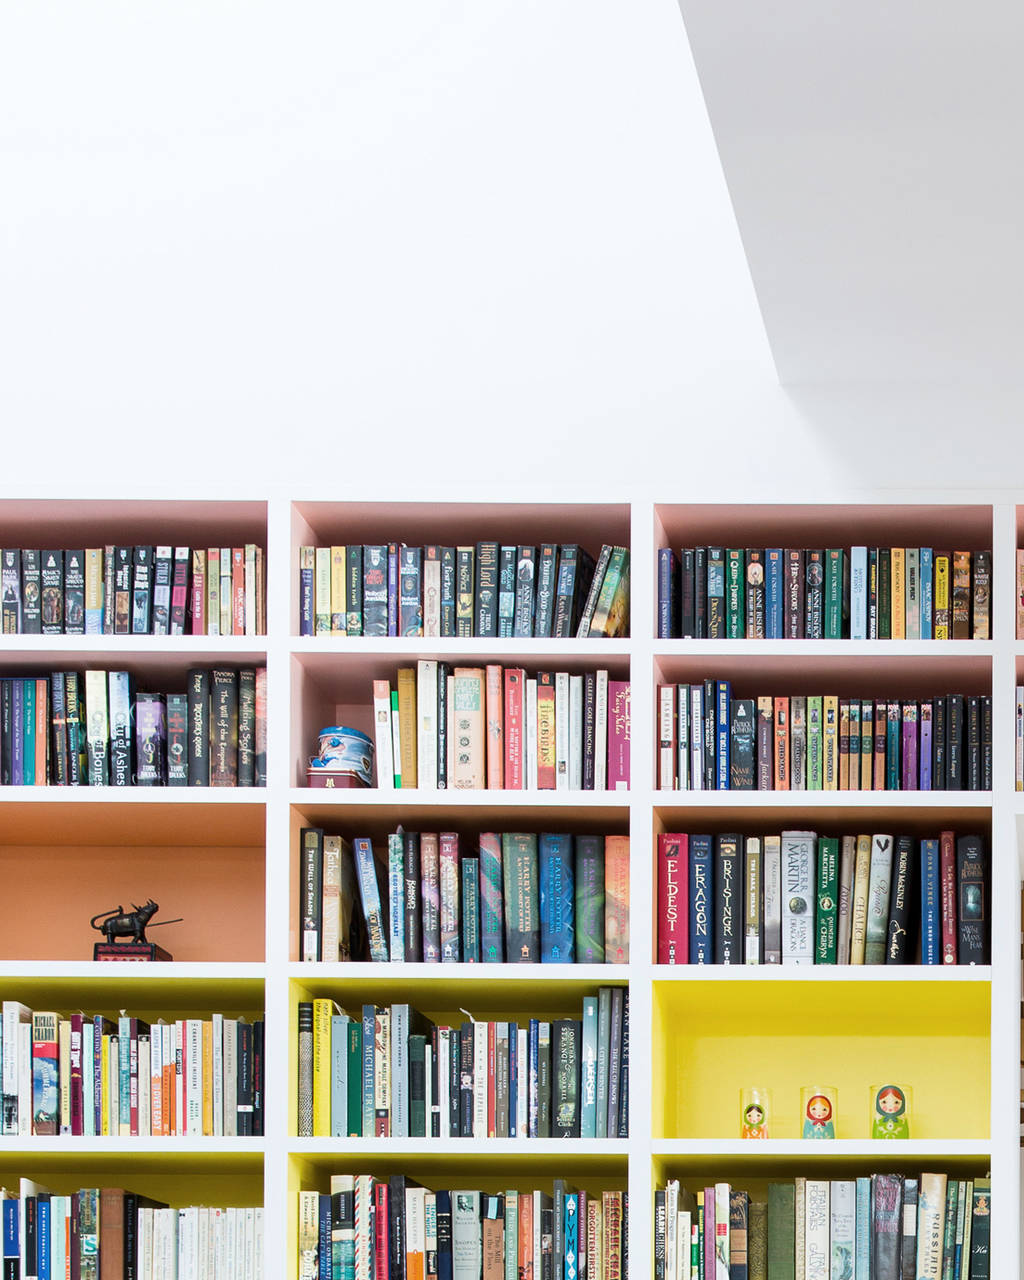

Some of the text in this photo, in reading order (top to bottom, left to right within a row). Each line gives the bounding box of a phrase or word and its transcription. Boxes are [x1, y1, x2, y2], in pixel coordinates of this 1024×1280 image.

[480, 545, 494, 587] High Lord
[667, 860, 678, 932] ELDEST
[696, 864, 707, 936] ERAGON
[723, 860, 734, 936] BRISINGR
[788, 843, 799, 893] MARTIN
